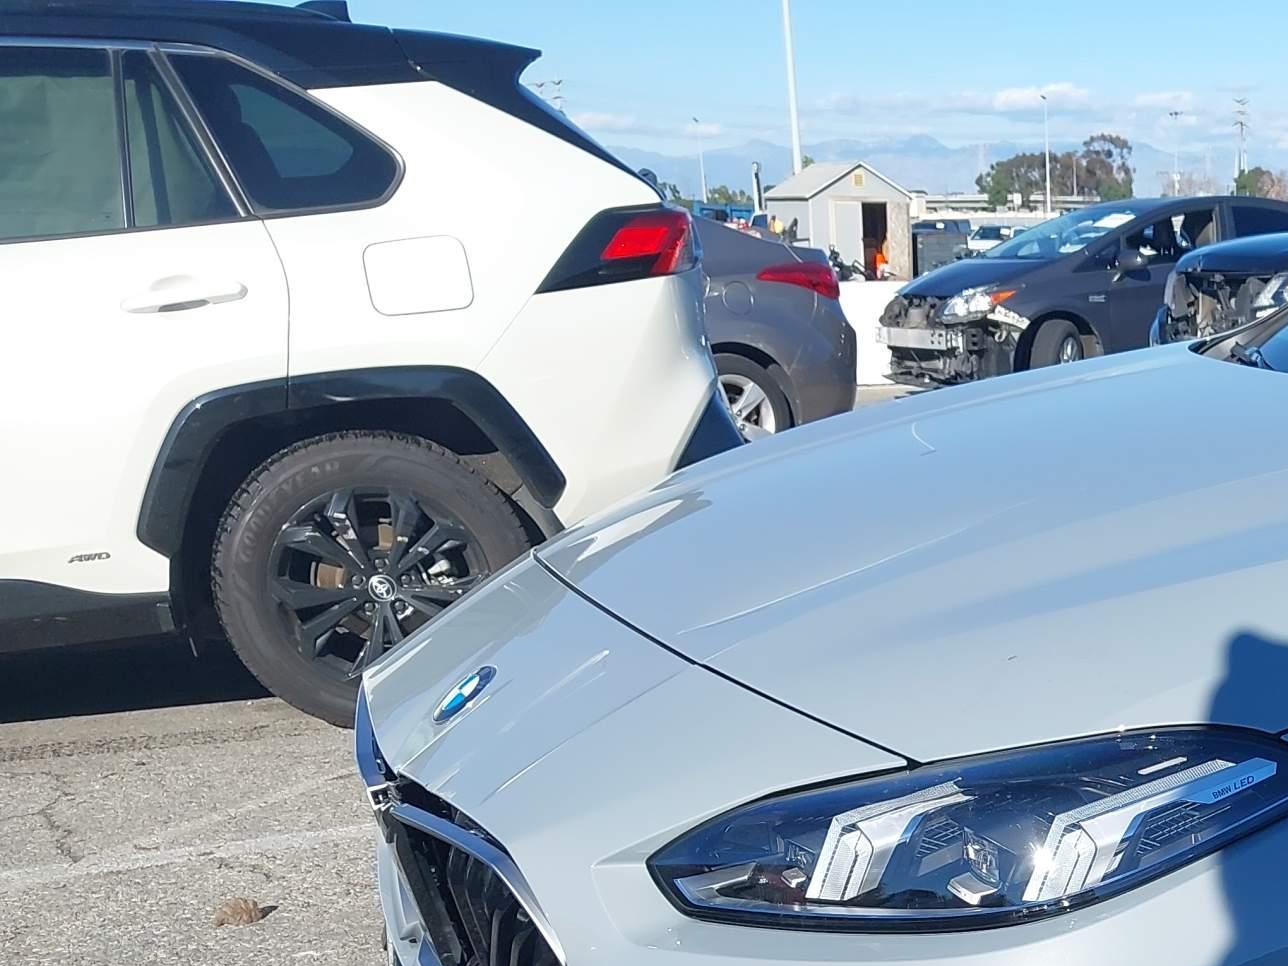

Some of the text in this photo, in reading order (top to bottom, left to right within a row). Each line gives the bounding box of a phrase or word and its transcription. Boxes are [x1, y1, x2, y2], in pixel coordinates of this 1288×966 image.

[67, 551, 111, 564] AWD
[1211, 775, 1255, 800] BMW LED
